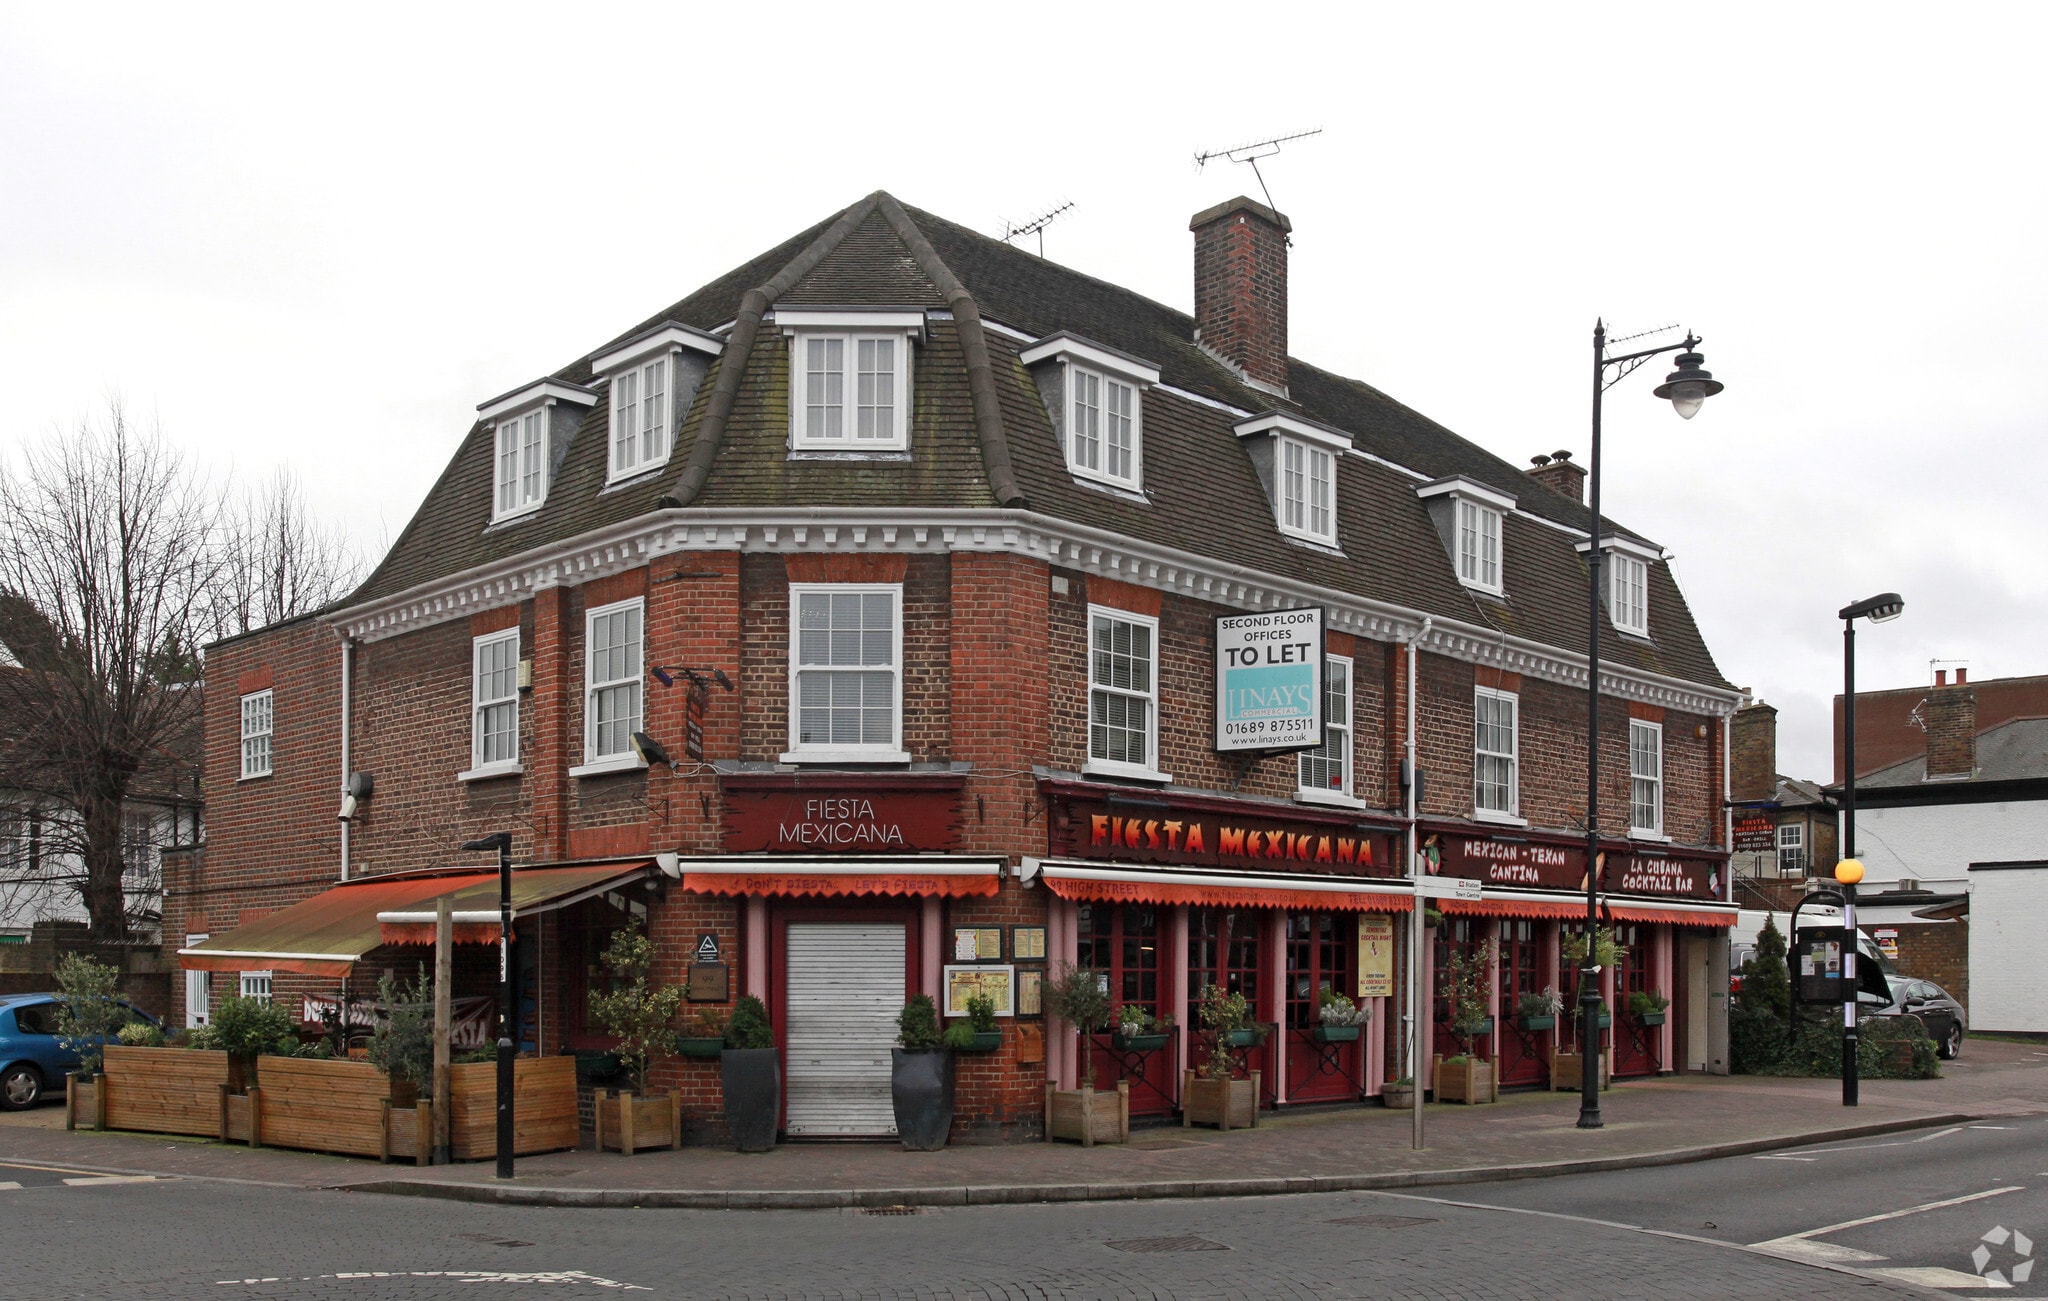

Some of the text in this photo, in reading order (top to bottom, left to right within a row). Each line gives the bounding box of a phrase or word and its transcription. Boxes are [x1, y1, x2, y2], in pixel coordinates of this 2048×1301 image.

[1222, 613, 1314, 630] SECOND FLOOR
[1244, 629, 1292, 642] OFFICES
[1225, 642, 1311, 667] TO LET
[1228, 684, 1311, 720] LINAYS
[1242, 707, 1297, 717] COMMERCIAL
[1226, 718, 1313, 735] 01689 875511
[1231, 733, 1307, 746] www.linays.co.uk
[807, 798, 875, 820] FIESTA
[779, 822, 903, 844] MEXICANA
[1091, 814, 1374, 867] FIESTA MEXICANA
[1464, 841, 1517, 860] MEXICAN
[1530, 847, 1565, 865] TEXAN
[1490, 863, 1539, 882] CANTINA
[1631, 858, 1683, 876] LA CUBANA
[747, 878, 782, 890] DON'T
[855, 879, 889, 890] LET'S
[894, 879, 938, 890] FIESTA
[1066, 882, 1094, 894] HIGH
[1097, 883, 1140, 895] STREET
[1622, 873, 1693, 892] COCKTAIL BAR
